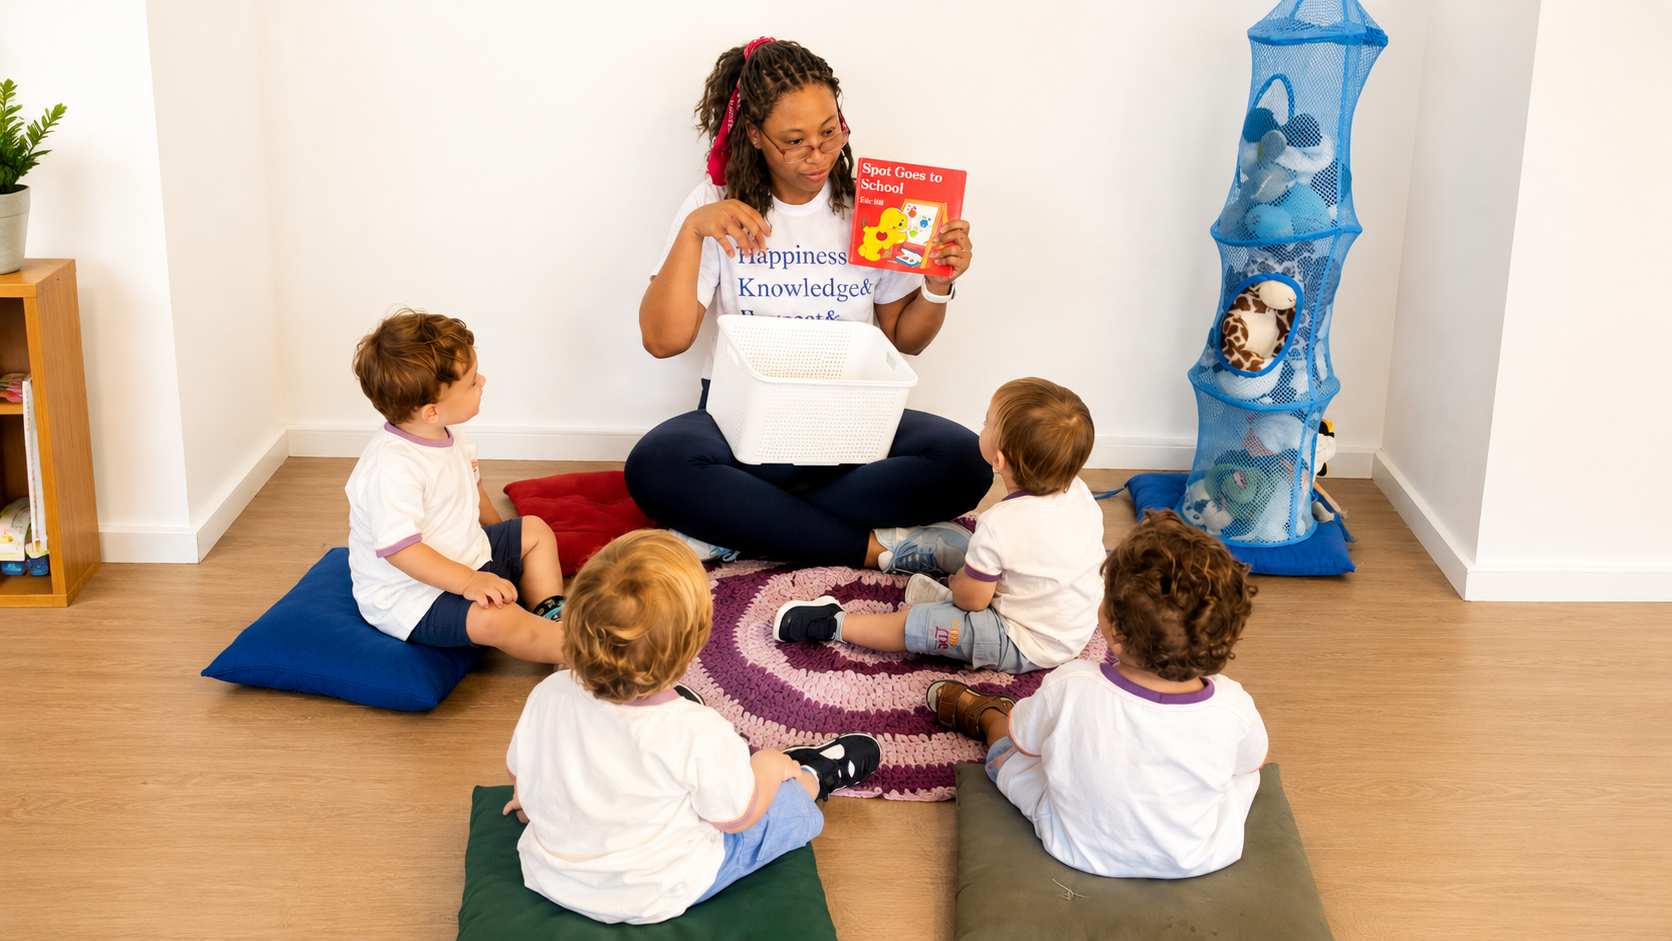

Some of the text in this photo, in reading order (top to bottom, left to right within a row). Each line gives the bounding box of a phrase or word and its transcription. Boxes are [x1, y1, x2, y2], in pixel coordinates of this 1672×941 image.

[862, 162, 943, 183] Spot Goes to
[860, 178, 904, 195] School
[738, 277, 874, 303] Knowledge&
